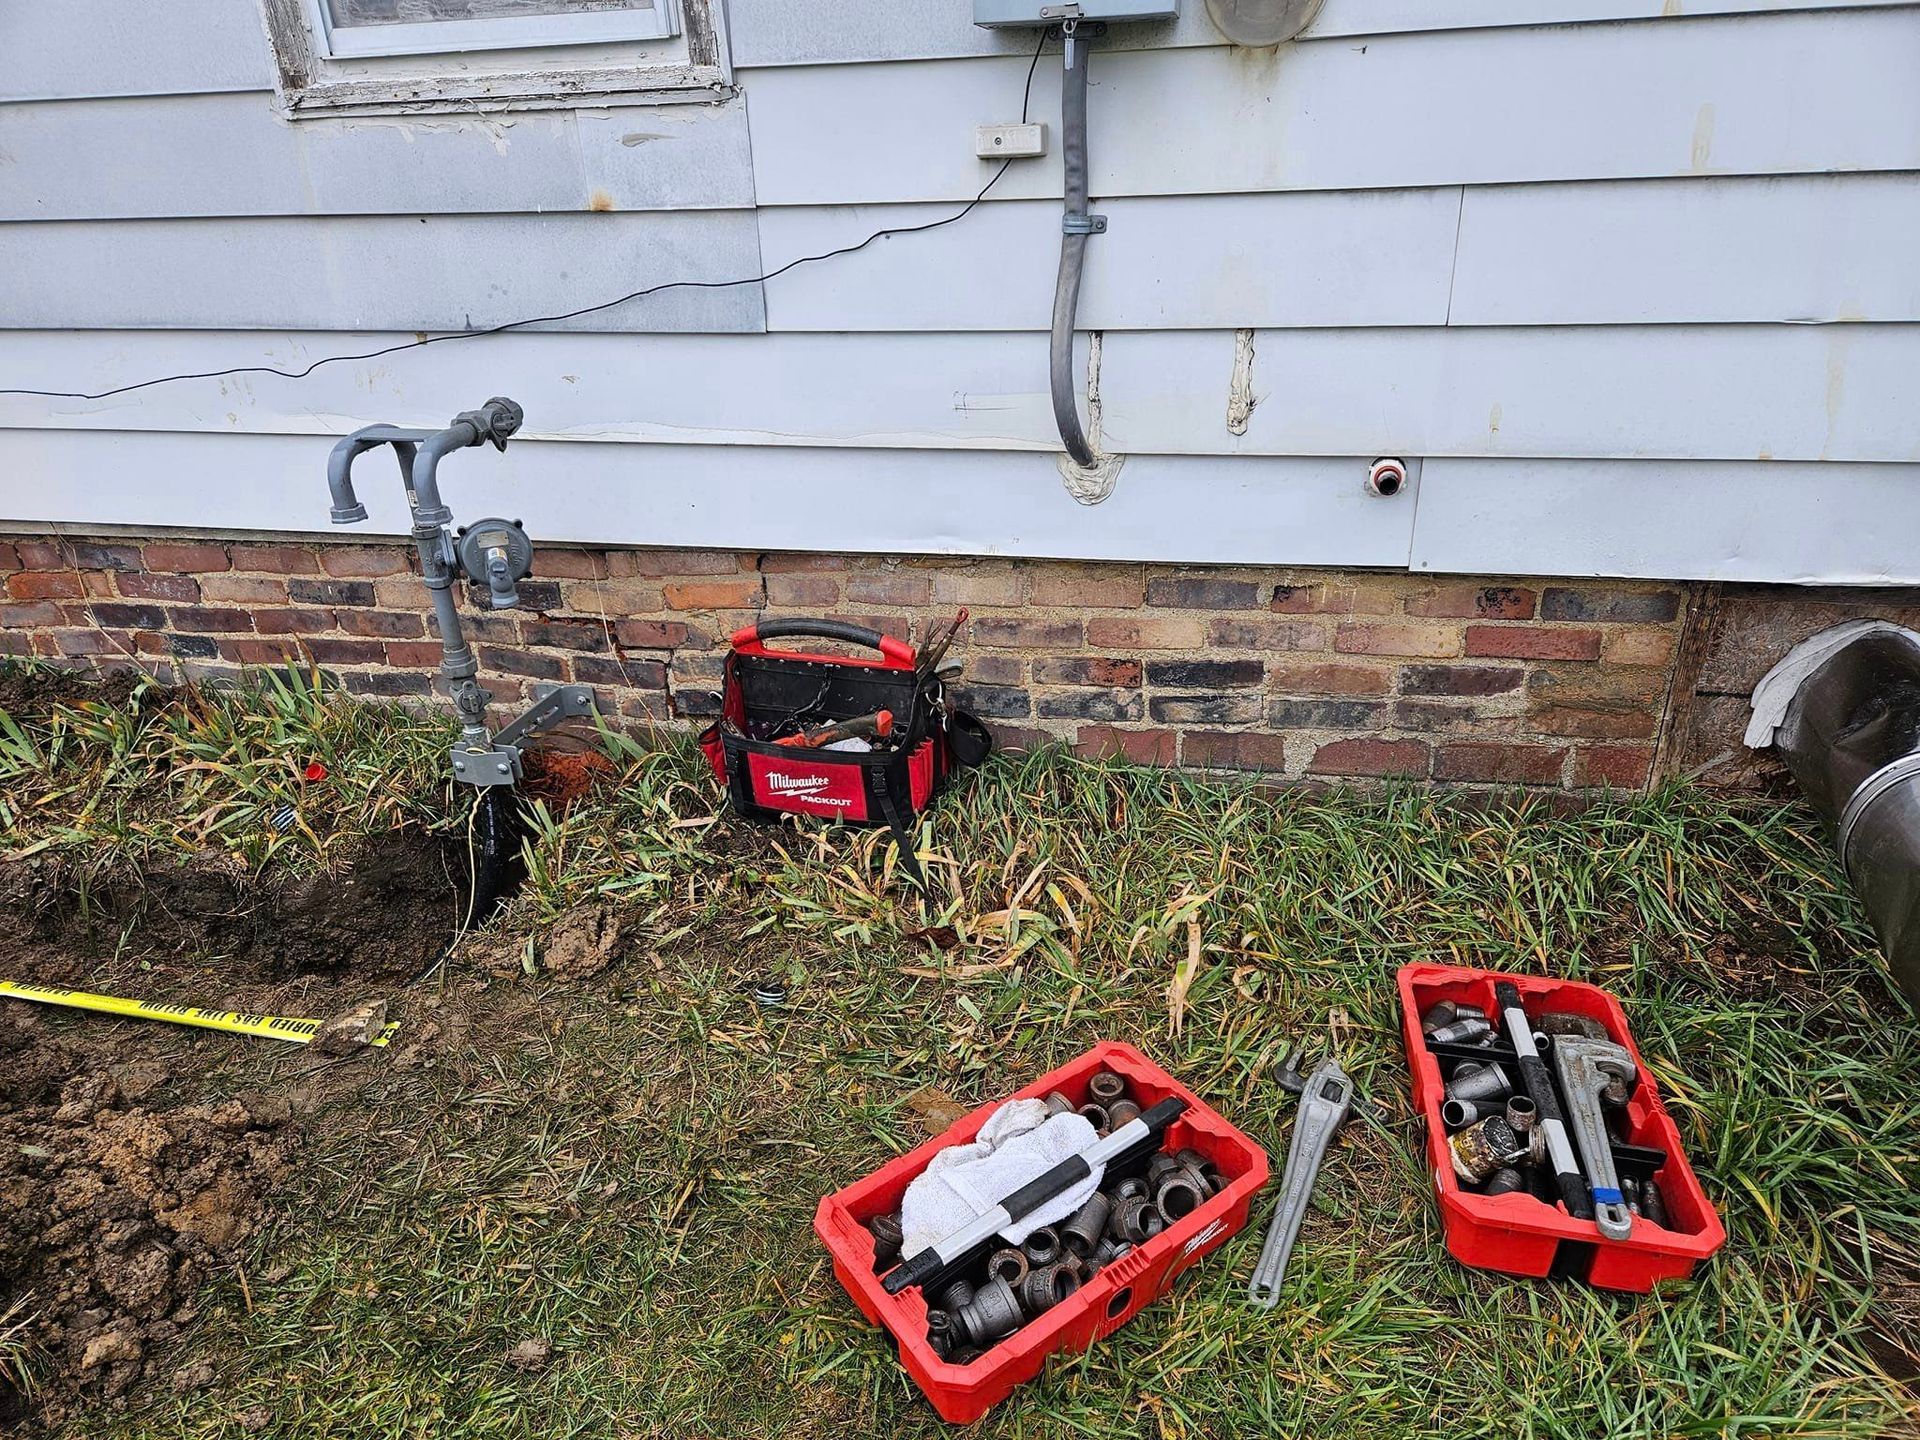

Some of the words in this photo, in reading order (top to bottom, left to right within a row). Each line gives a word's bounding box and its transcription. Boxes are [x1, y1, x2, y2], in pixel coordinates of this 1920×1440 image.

[765, 771, 829, 789] Milwaukee
[801, 795, 852, 806] PACKOUT
[232, 1013, 265, 1026] GAS
